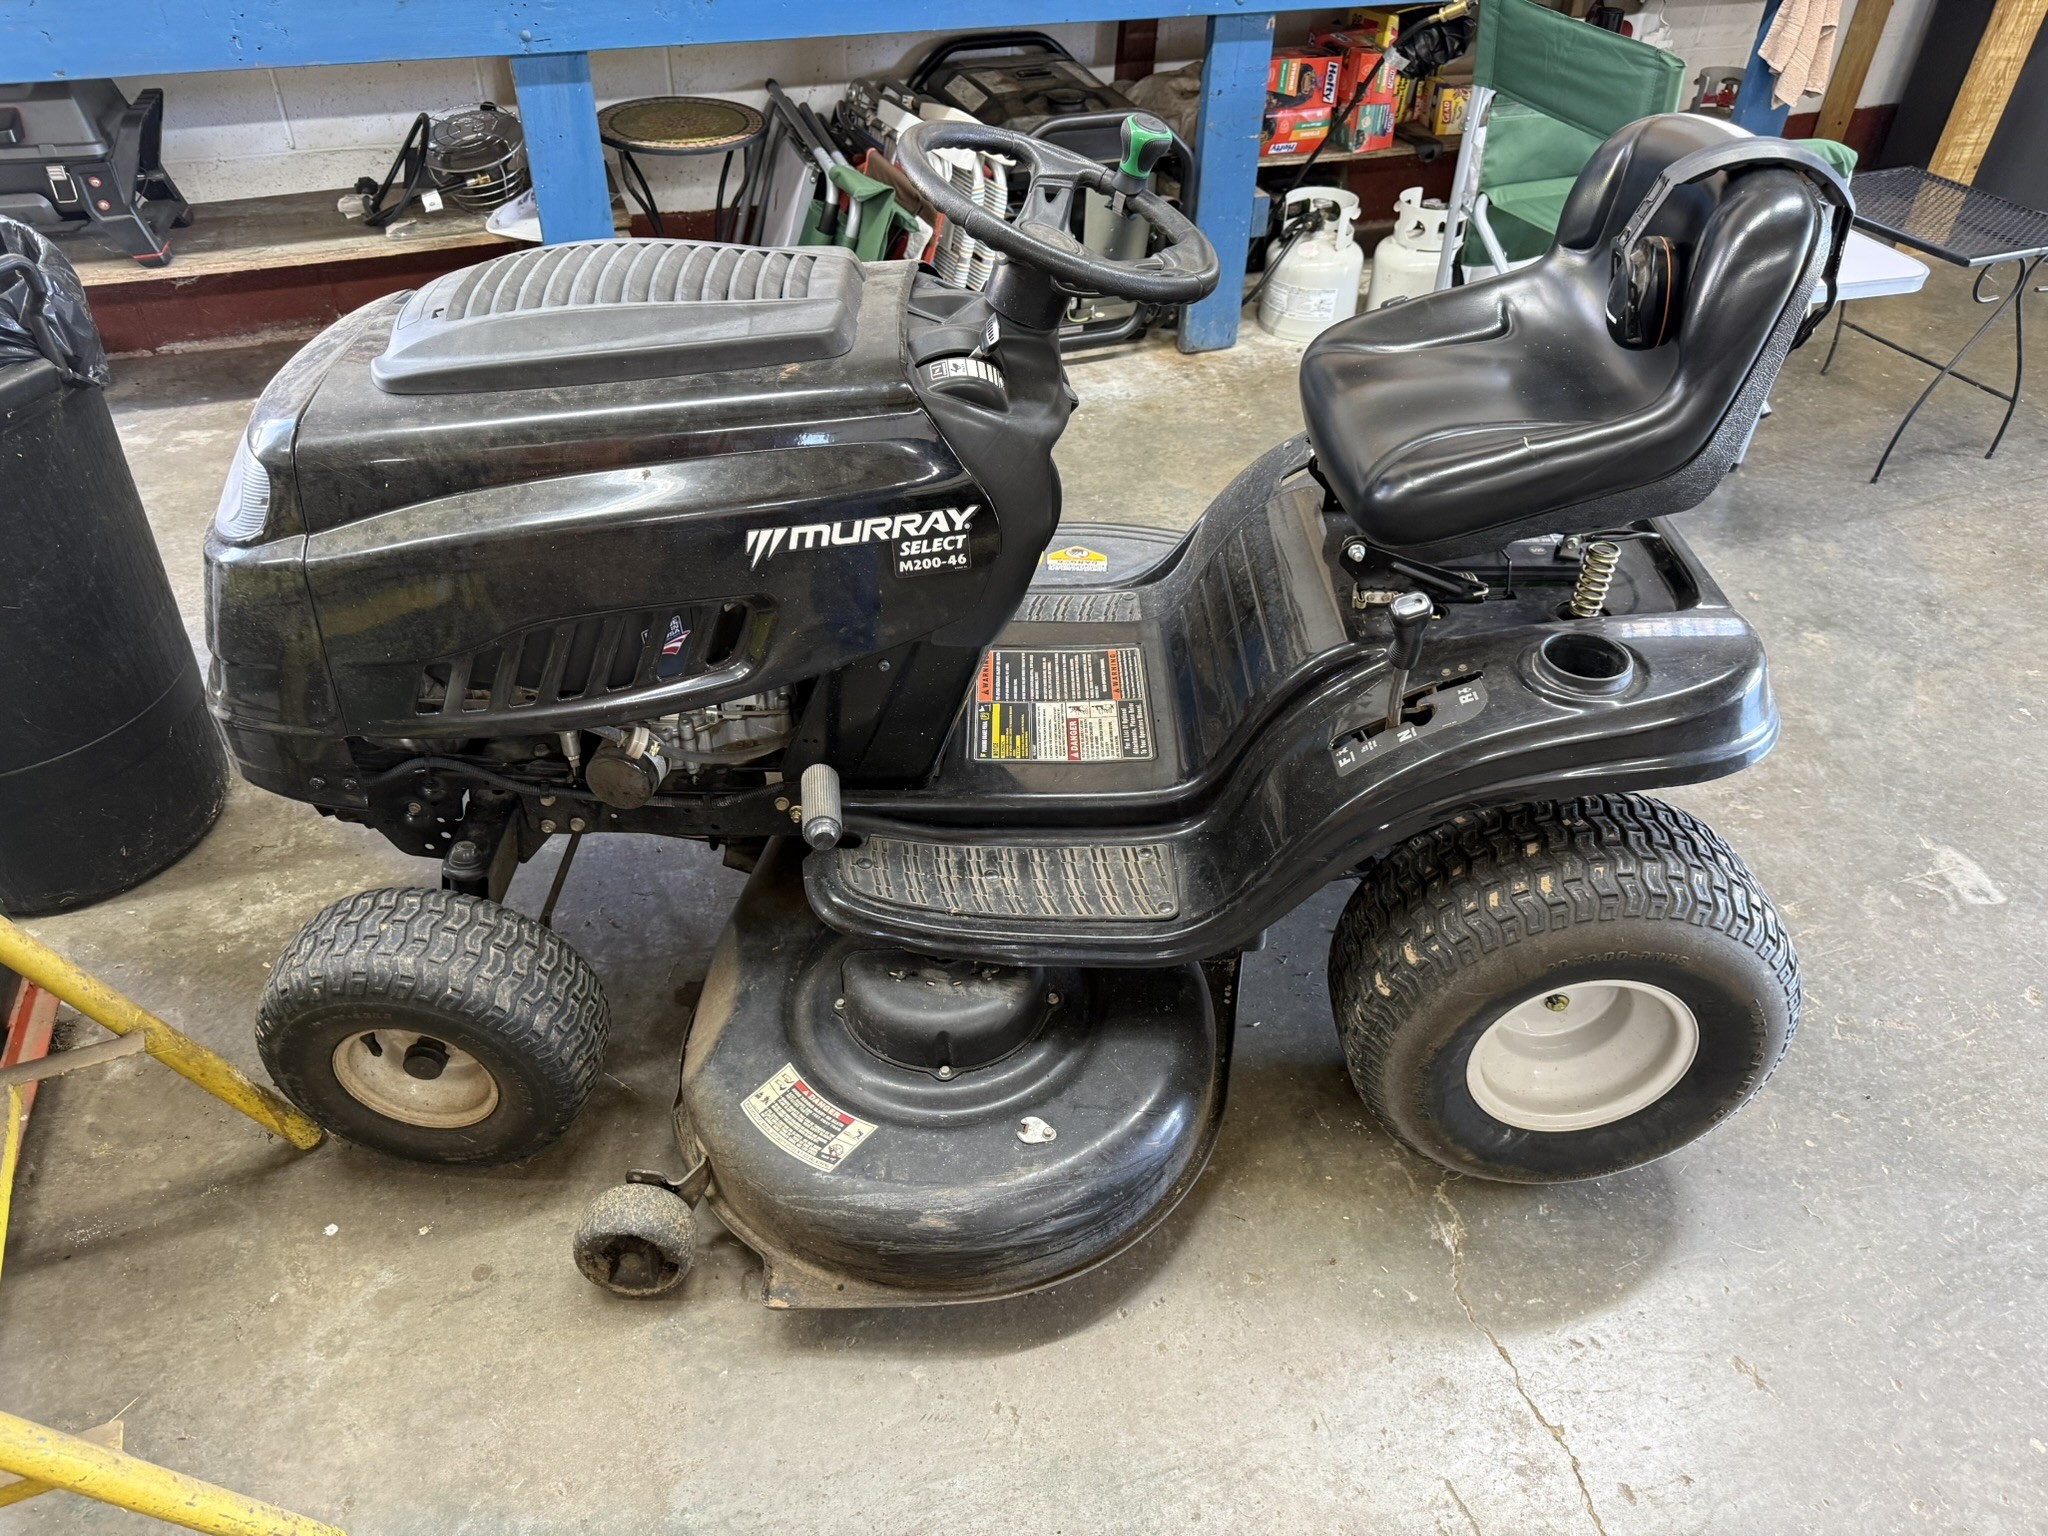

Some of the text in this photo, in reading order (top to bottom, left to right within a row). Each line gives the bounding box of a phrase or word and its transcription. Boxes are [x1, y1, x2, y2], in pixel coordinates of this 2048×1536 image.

[1324, 63, 1338, 102] Hefty
[1443, 101, 1451, 123] GLAD
[1270, 143, 1295, 152] Hefty
[789, 505, 980, 550] MURRAY
[900, 534, 967, 557] SELECT
[899, 554, 967, 573] M200-46
[1110, 653, 1119, 687] WARNING
[1458, 692, 1475, 706] R
[1069, 720, 1078, 751] DANGER
[1397, 729, 1412, 743] N
[1338, 757, 1352, 768] F
[808, 1092, 841, 1118] DANGER
